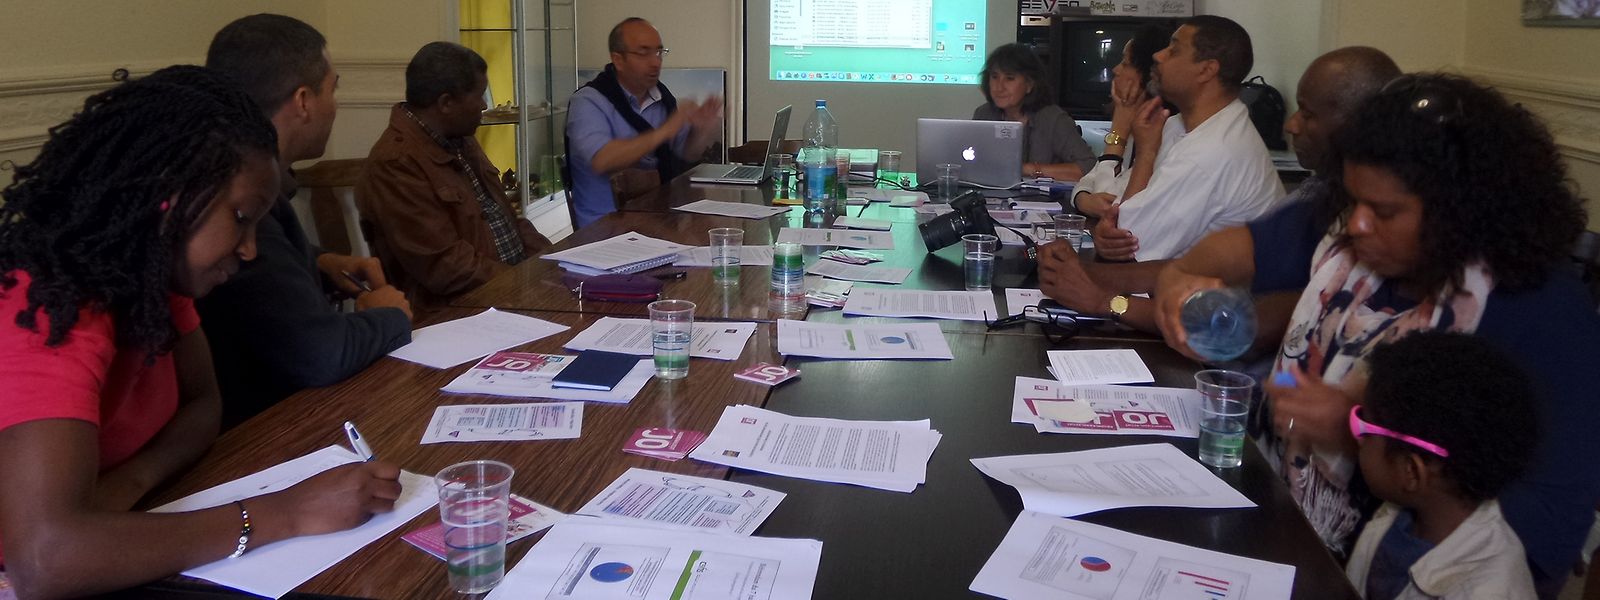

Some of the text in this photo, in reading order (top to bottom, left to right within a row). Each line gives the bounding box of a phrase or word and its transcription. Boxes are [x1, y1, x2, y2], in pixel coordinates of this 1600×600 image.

[486, 359, 531, 369] JO
[1122, 412, 1166, 425] JO
[635, 428, 673, 449] JO
